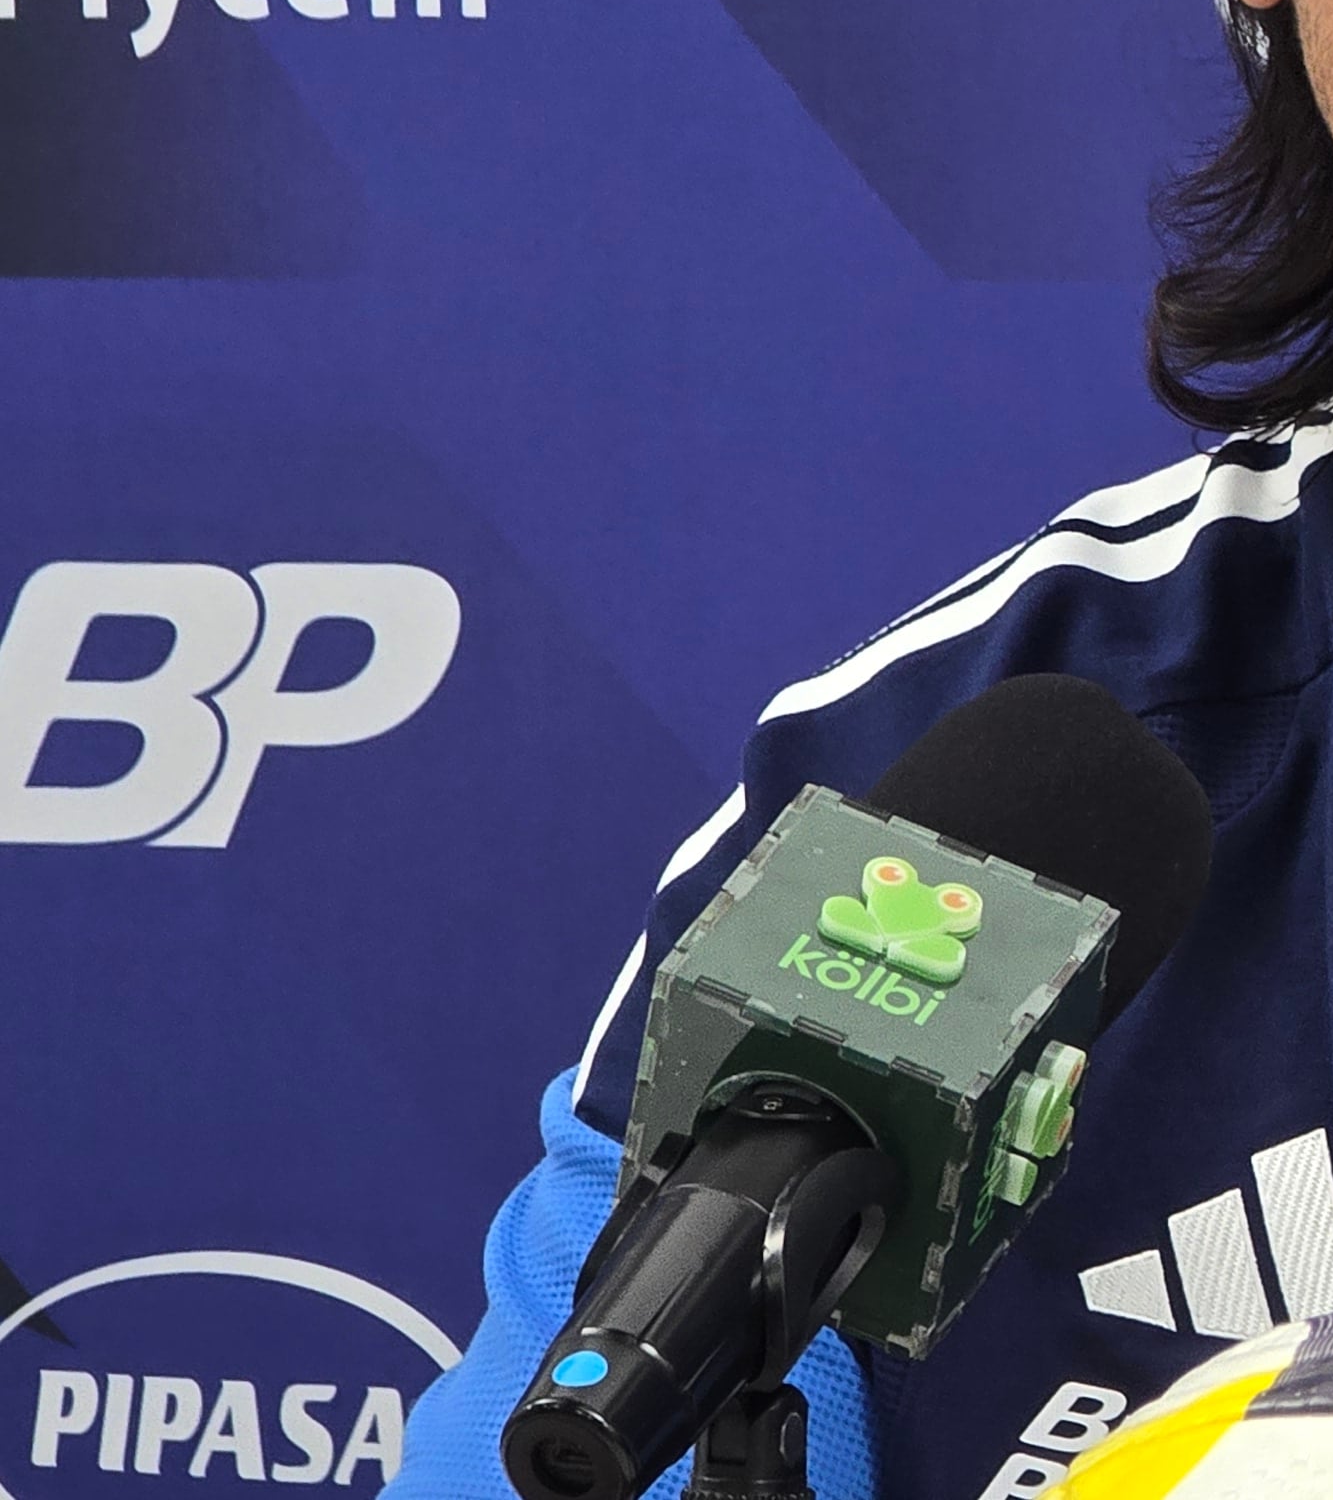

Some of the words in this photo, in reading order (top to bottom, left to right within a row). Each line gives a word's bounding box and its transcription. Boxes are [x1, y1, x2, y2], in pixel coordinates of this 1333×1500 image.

[0, 561, 461, 848] BP
[778, 933, 946, 1026] kölbi
[31, 1369, 404, 1486] PIPASA
